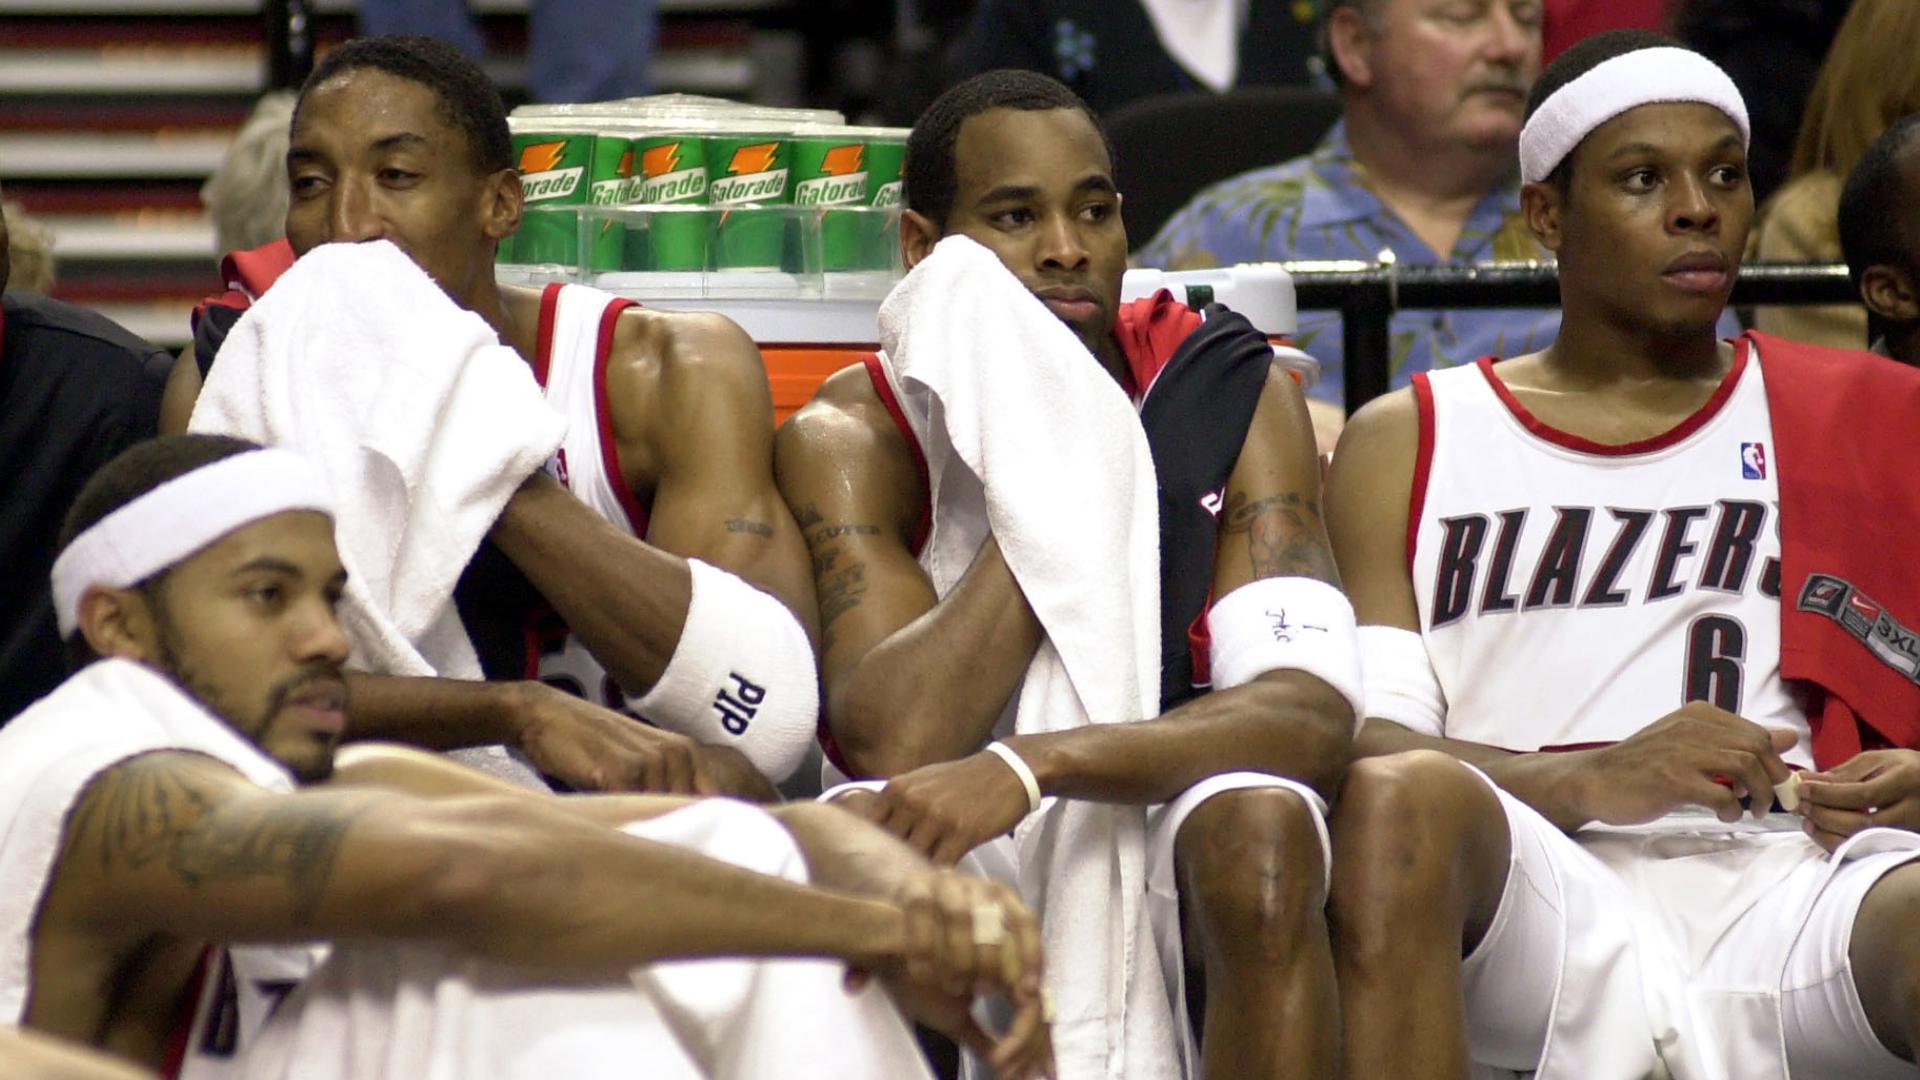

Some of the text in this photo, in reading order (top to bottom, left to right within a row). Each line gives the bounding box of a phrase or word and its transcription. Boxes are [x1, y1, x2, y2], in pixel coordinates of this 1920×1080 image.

[521, 173, 575, 197] orade
[645, 172, 704, 203] orade
[711, 175, 784, 201] Gatorade
[1878, 617, 1919, 658] 3XL
[1681, 613, 1748, 715] 6
